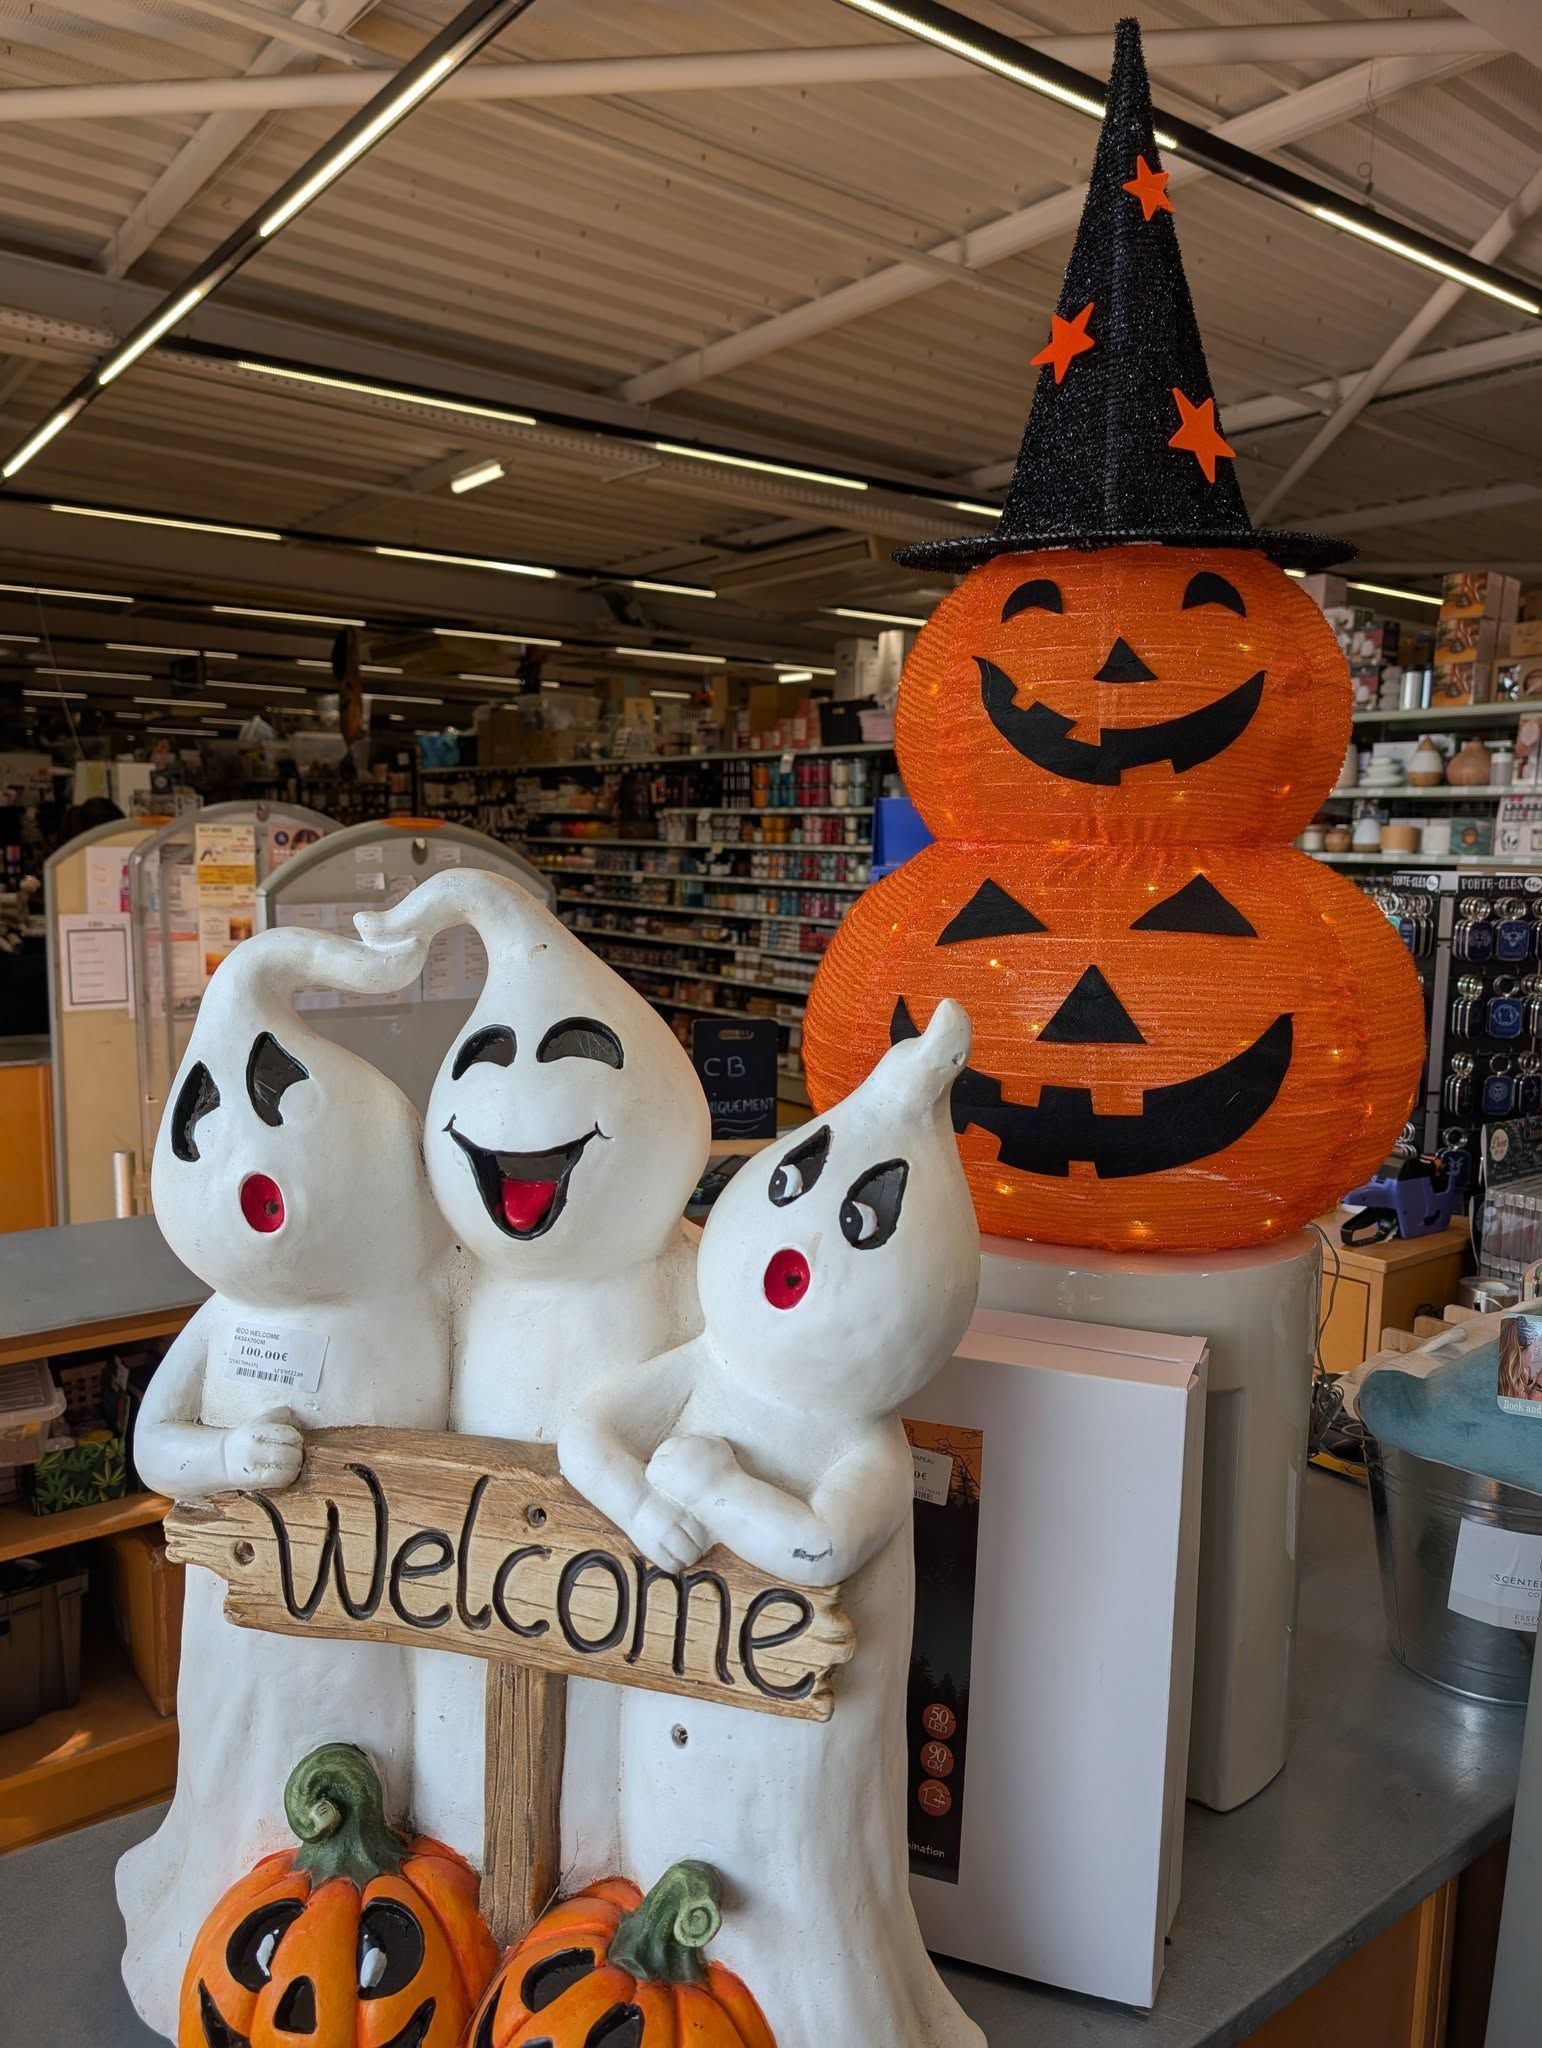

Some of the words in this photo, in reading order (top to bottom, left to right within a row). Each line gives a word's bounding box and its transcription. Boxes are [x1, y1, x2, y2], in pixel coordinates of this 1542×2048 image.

[249, 1328, 281, 1341] WELCOME
[240, 1345, 289, 1362] 100.00€
[1503, 1400, 1525, 1412] Book
[1526, 1403, 1542, 1415] and
[913, 1470, 928, 1481] 0€
[240, 1462, 816, 1701] Welcome
[1514, 1613, 1537, 1623] ESSE
[930, 1706, 949, 1725] 50
[928, 1720, 948, 1733] LED
[929, 1744, 947, 1763] 90
[927, 1759, 943, 1772] CM
